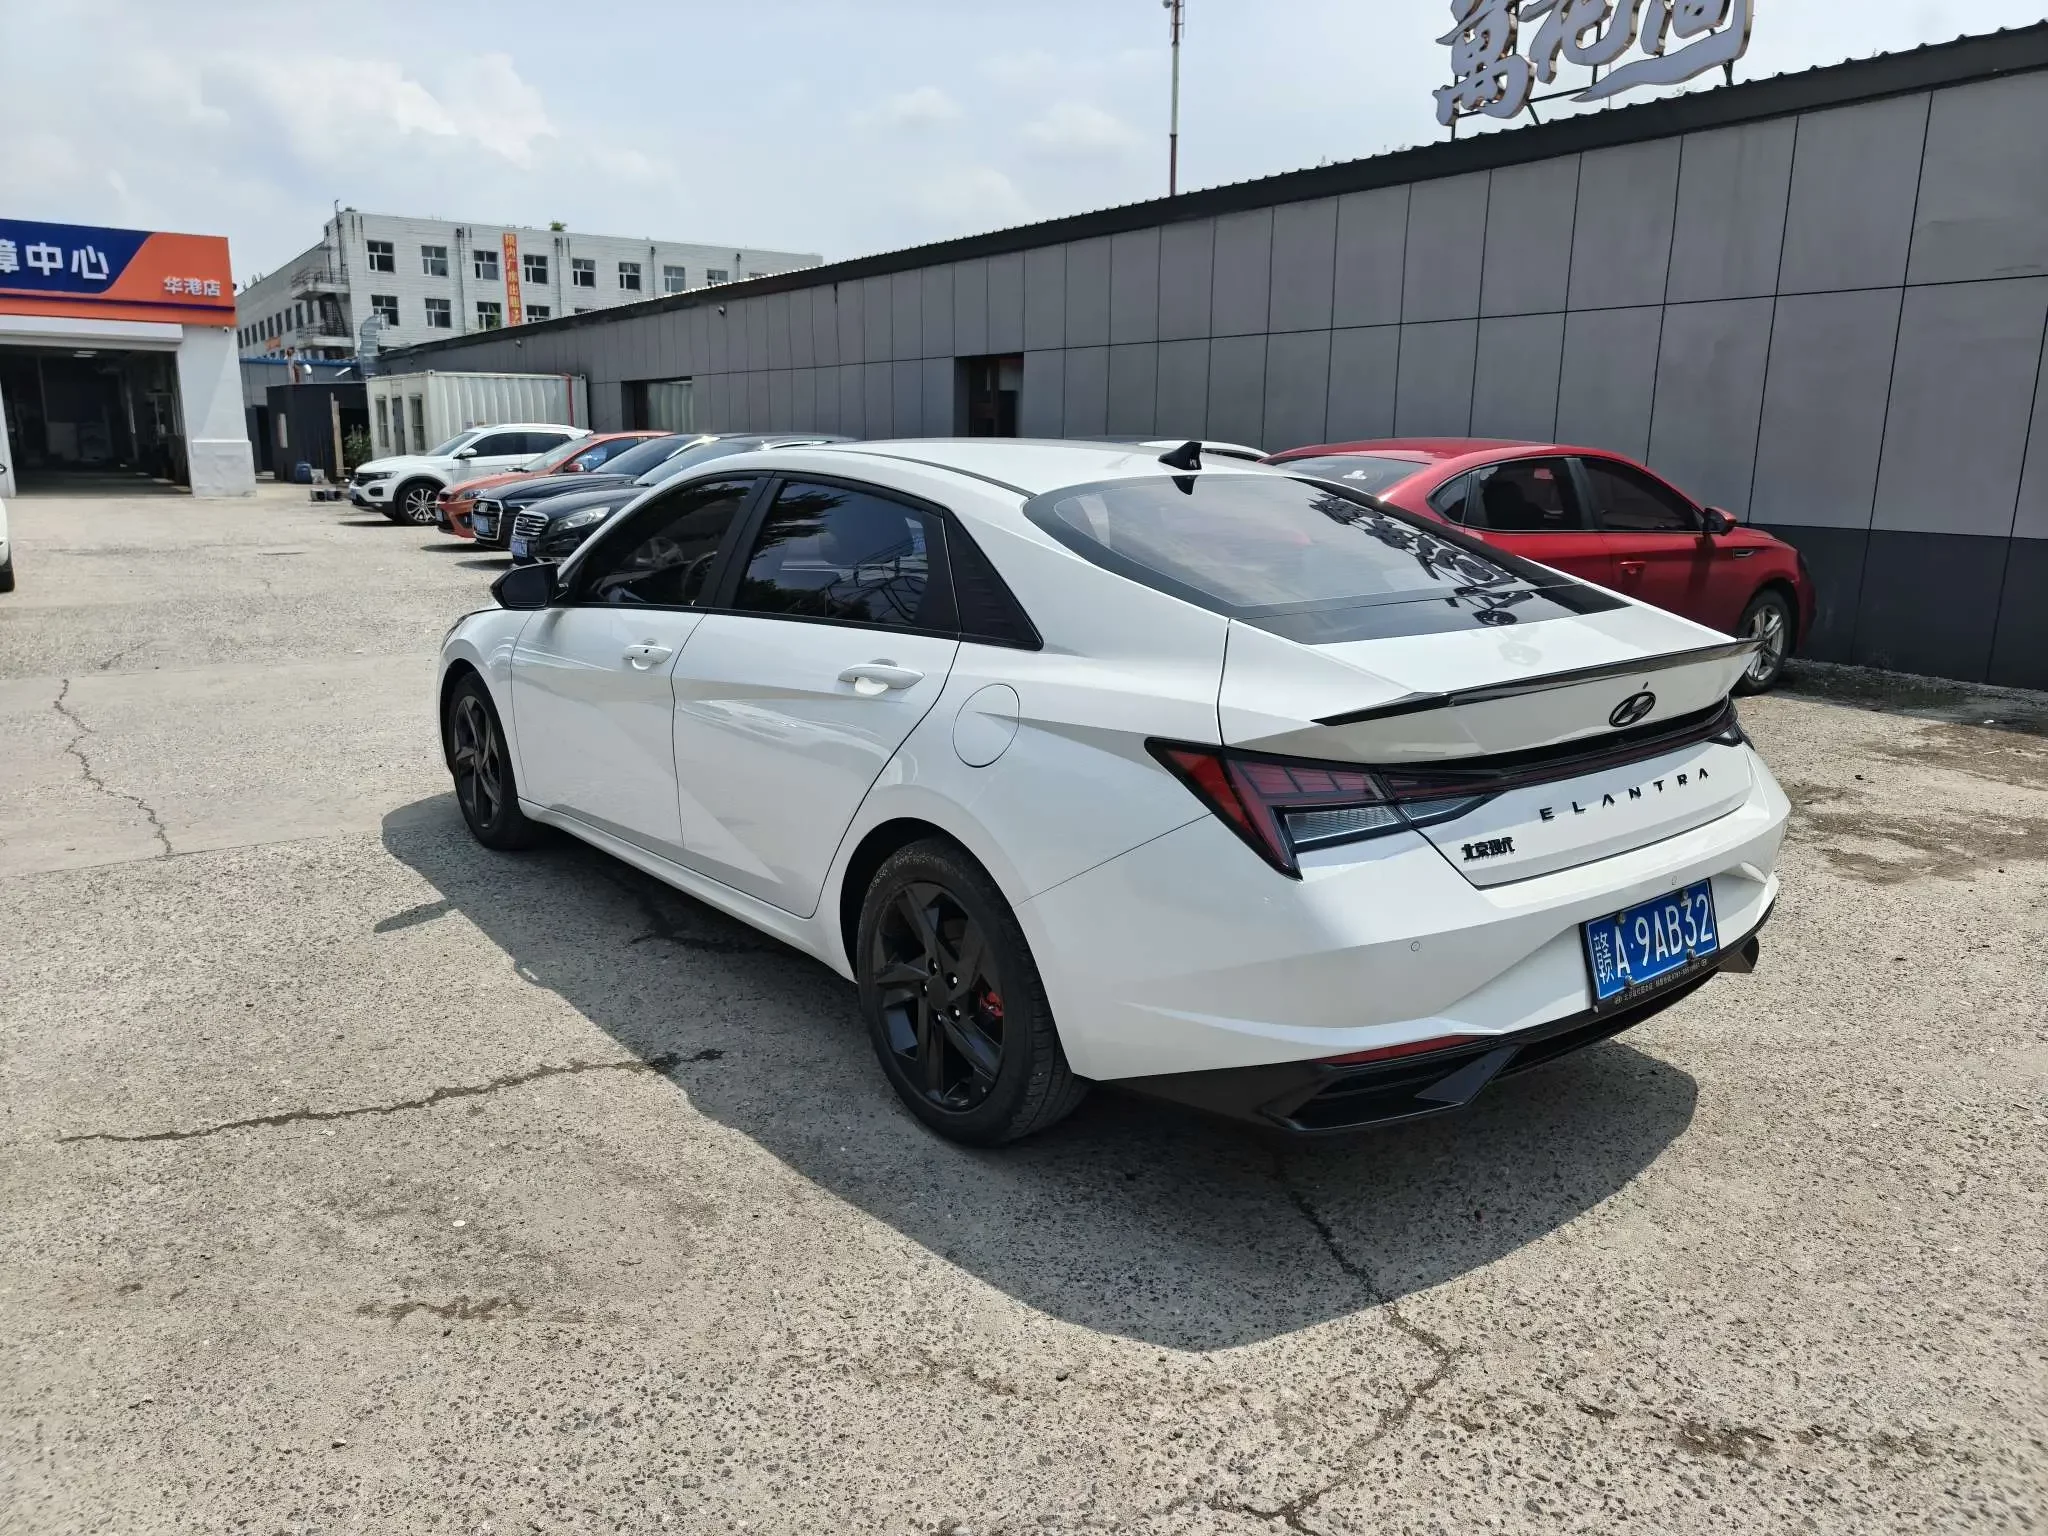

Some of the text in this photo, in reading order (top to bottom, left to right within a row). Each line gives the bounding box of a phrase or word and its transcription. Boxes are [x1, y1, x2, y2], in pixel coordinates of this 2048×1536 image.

[163, 275, 222, 298] 华港店
[1539, 767, 1709, 822] ELANTRA
